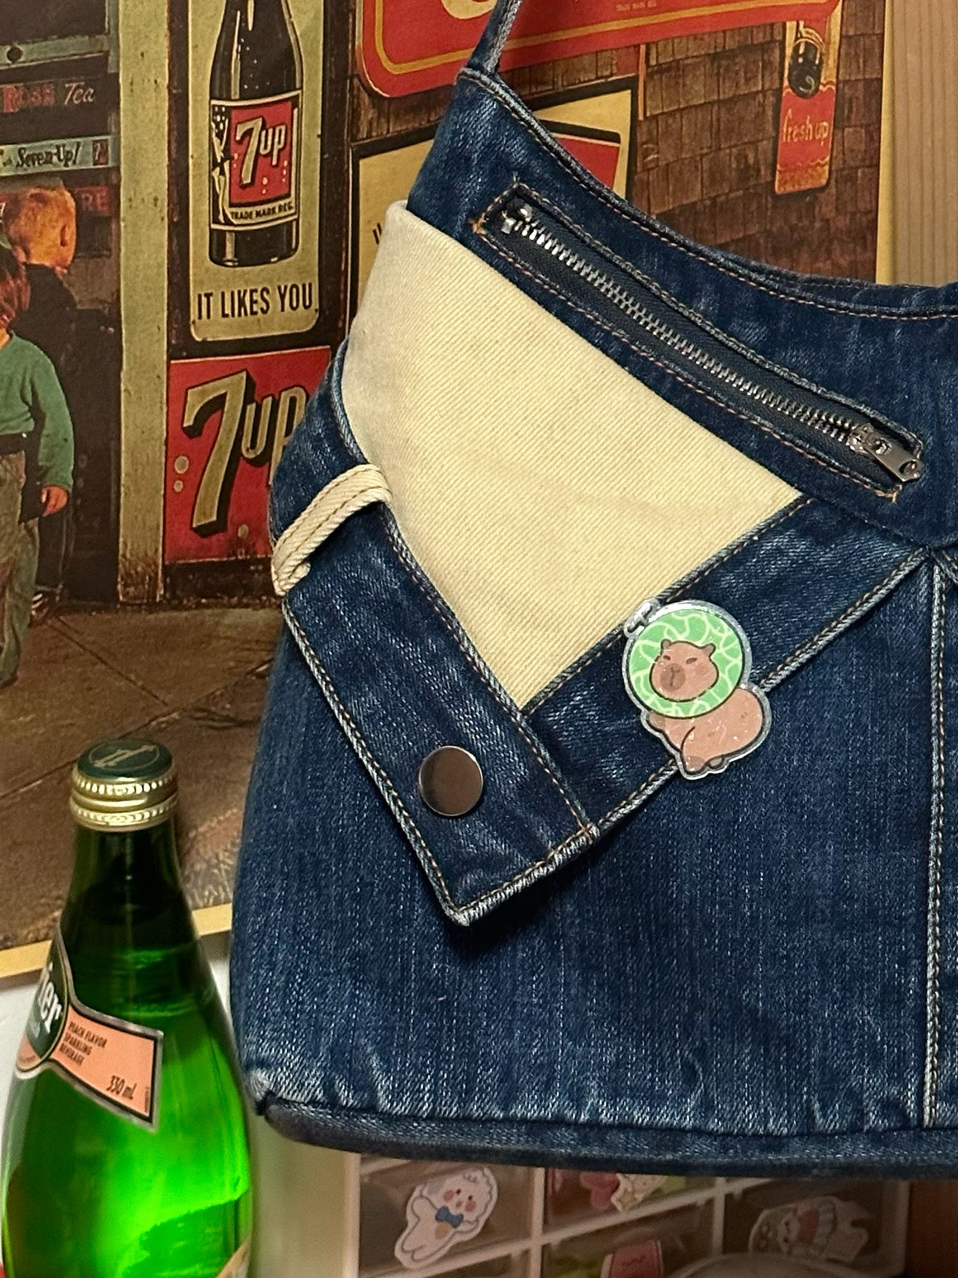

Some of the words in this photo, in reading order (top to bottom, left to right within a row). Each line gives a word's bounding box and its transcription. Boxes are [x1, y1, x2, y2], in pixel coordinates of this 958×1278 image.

[64, 82, 94, 105] Tea
[782, 109, 813, 142] fresh
[815, 122, 828, 146] up
[231, 211, 253, 221] TRADE
[255, 208, 276, 218] MARK
[198, 293, 213, 320] IT
[220, 287, 270, 319] LIKES
[278, 281, 313, 311] YOU
[85, 1030, 107, 1049] FLAVOR
[106, 1075, 125, 1096] 330
